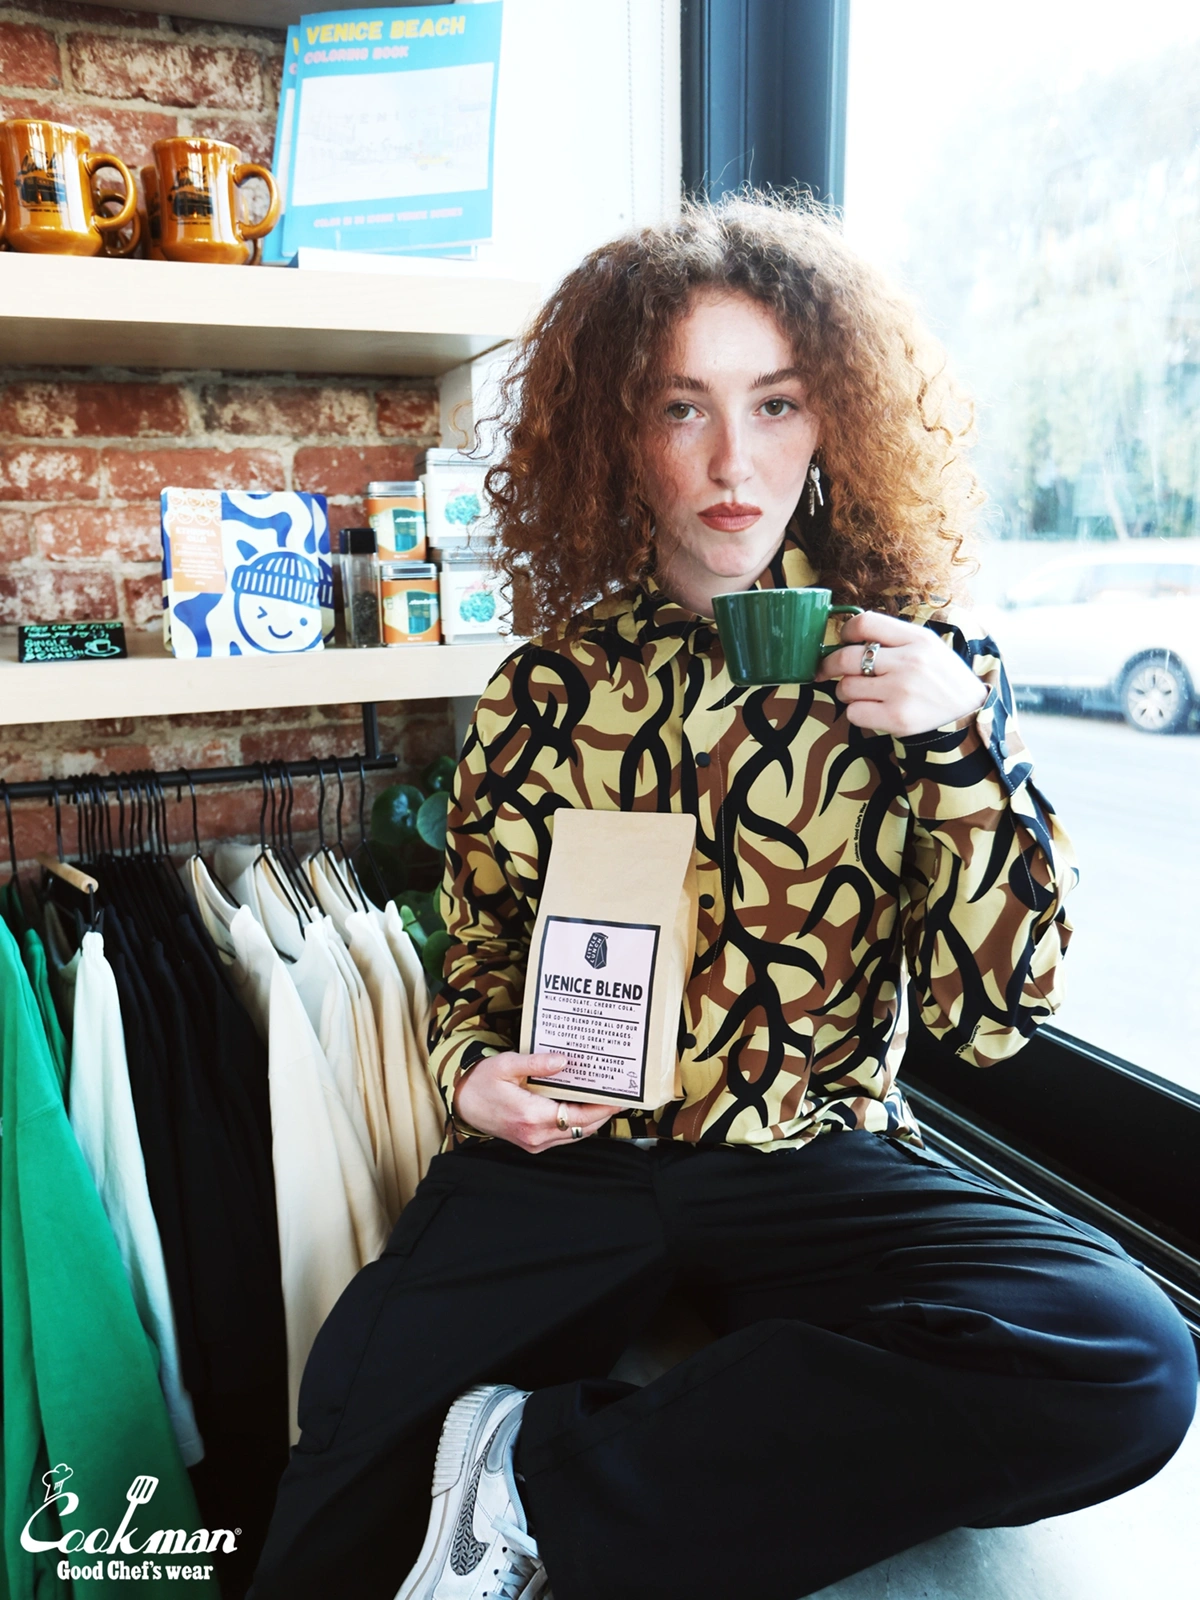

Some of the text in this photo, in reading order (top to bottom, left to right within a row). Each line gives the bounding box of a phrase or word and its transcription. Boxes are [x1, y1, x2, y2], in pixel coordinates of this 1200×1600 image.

[306, 16, 466, 45] VENICE BEACH
[304, 46, 409, 64] COLORING BOOK
[25, 639, 68, 648] SINGLE
[26, 645, 74, 653] ORIGIN
[586, 935, 598, 959] LITTLE
[590, 937, 602, 964] LUNCH
[544, 974, 642, 1000] VENICE BLEND
[573, 1007, 603, 1015] NOSTALGIA
[567, 1025, 595, 1033] ESPRESSO
[598, 1030, 633, 1039] BEVERAGES.
[589, 1072, 614, 1080] ETHIOPIA
